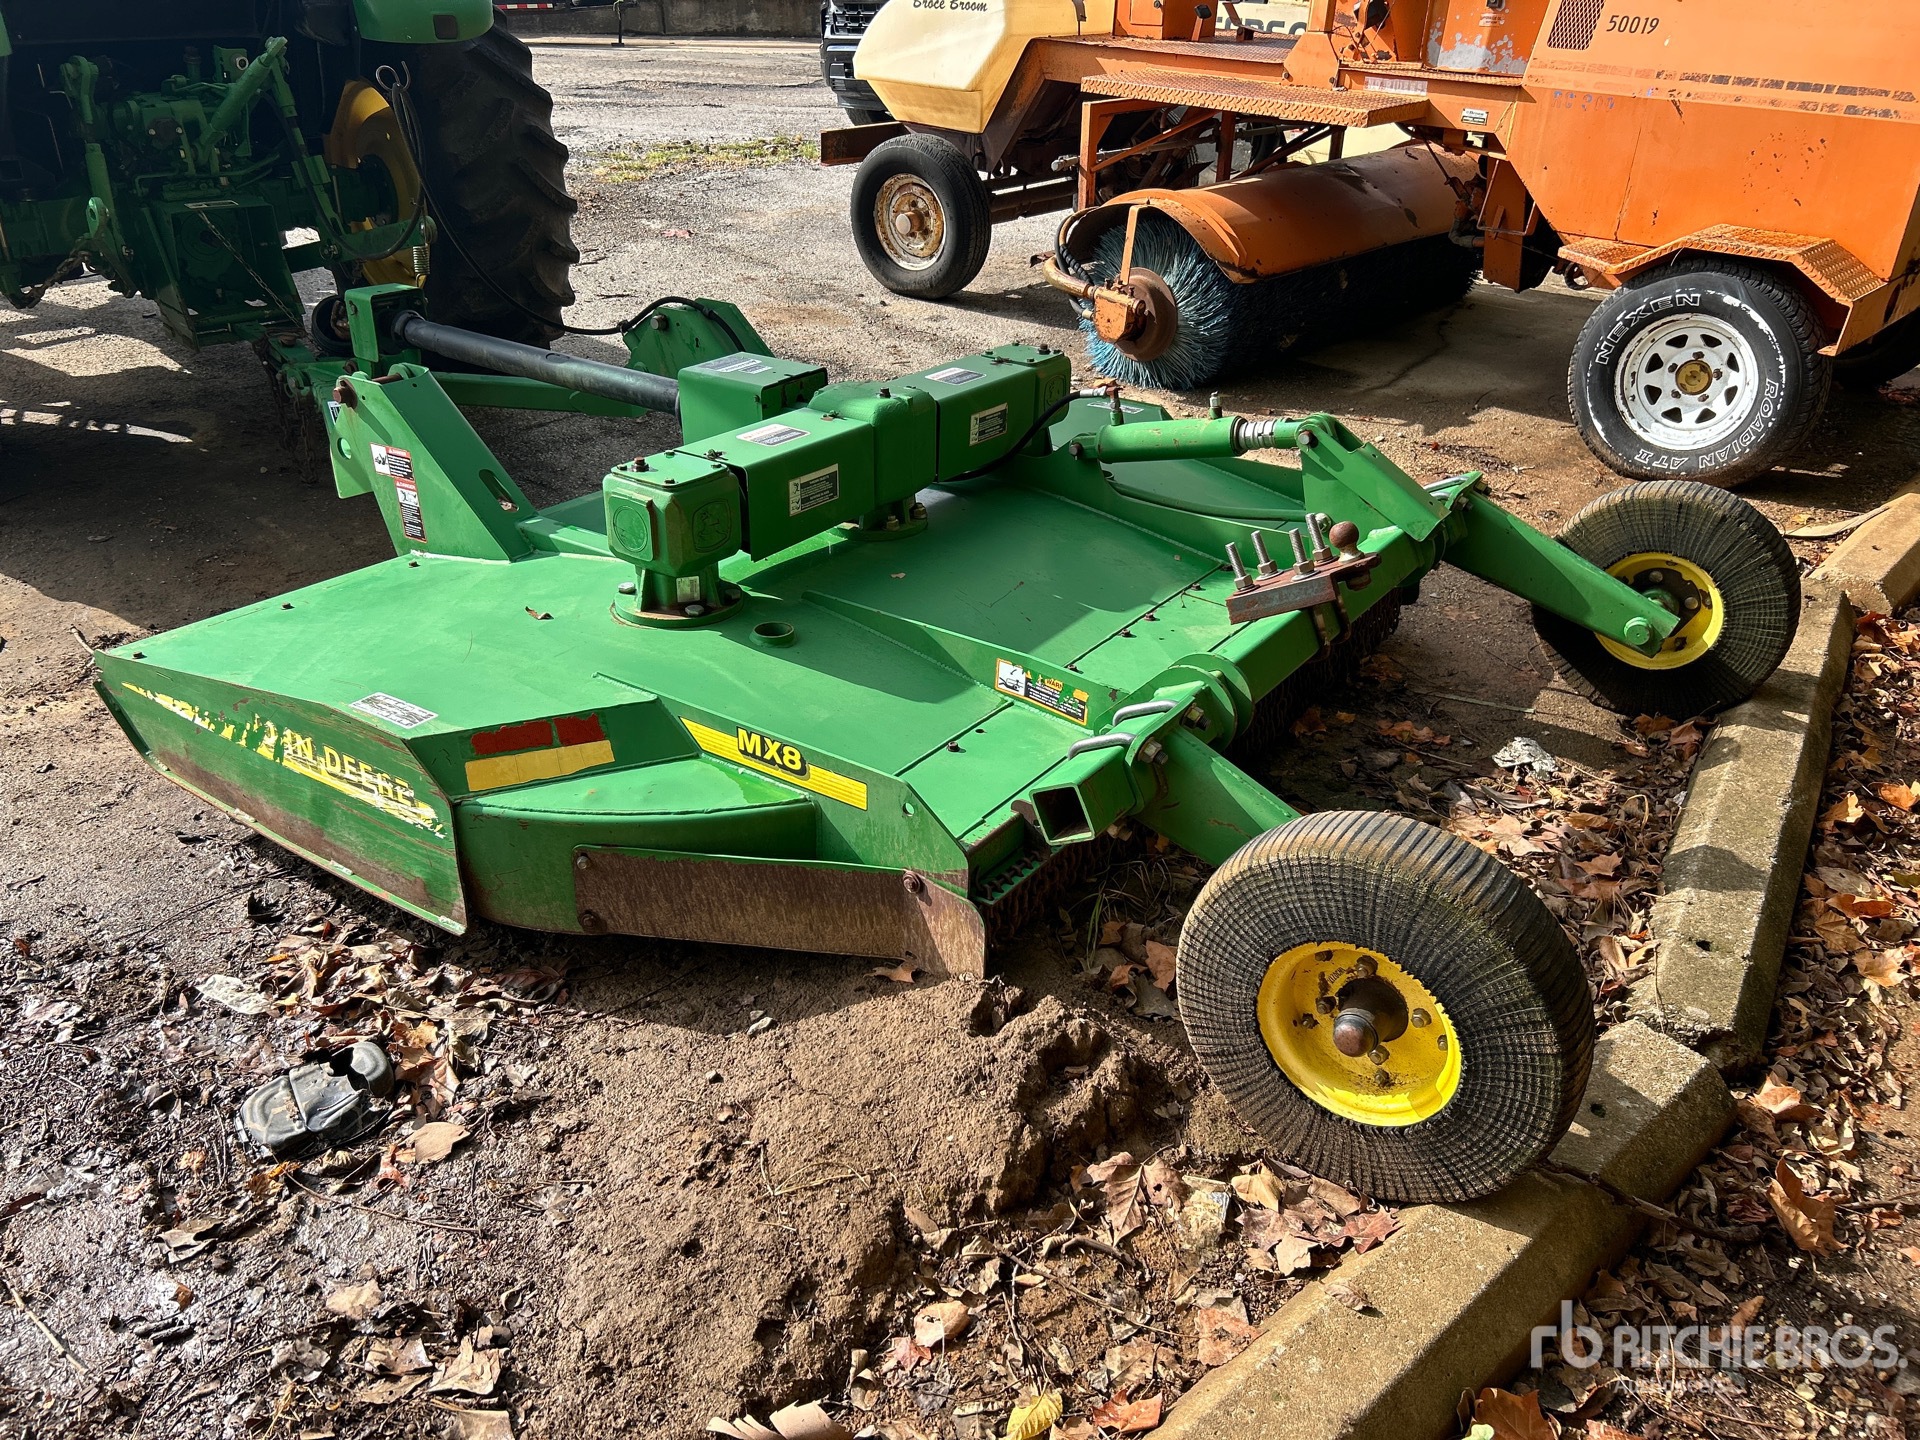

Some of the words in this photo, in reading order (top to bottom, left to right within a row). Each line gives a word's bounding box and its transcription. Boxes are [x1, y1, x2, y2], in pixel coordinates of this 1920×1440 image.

[950, 0, 988, 12] Broom
[1606, 14, 1659, 34] 50019
[1595, 293, 1701, 365] NEXEN
[1698, 377, 1779, 469] ROADIAN
[323, 744, 415, 806] DEERE
[737, 728, 804, 770] MX8
